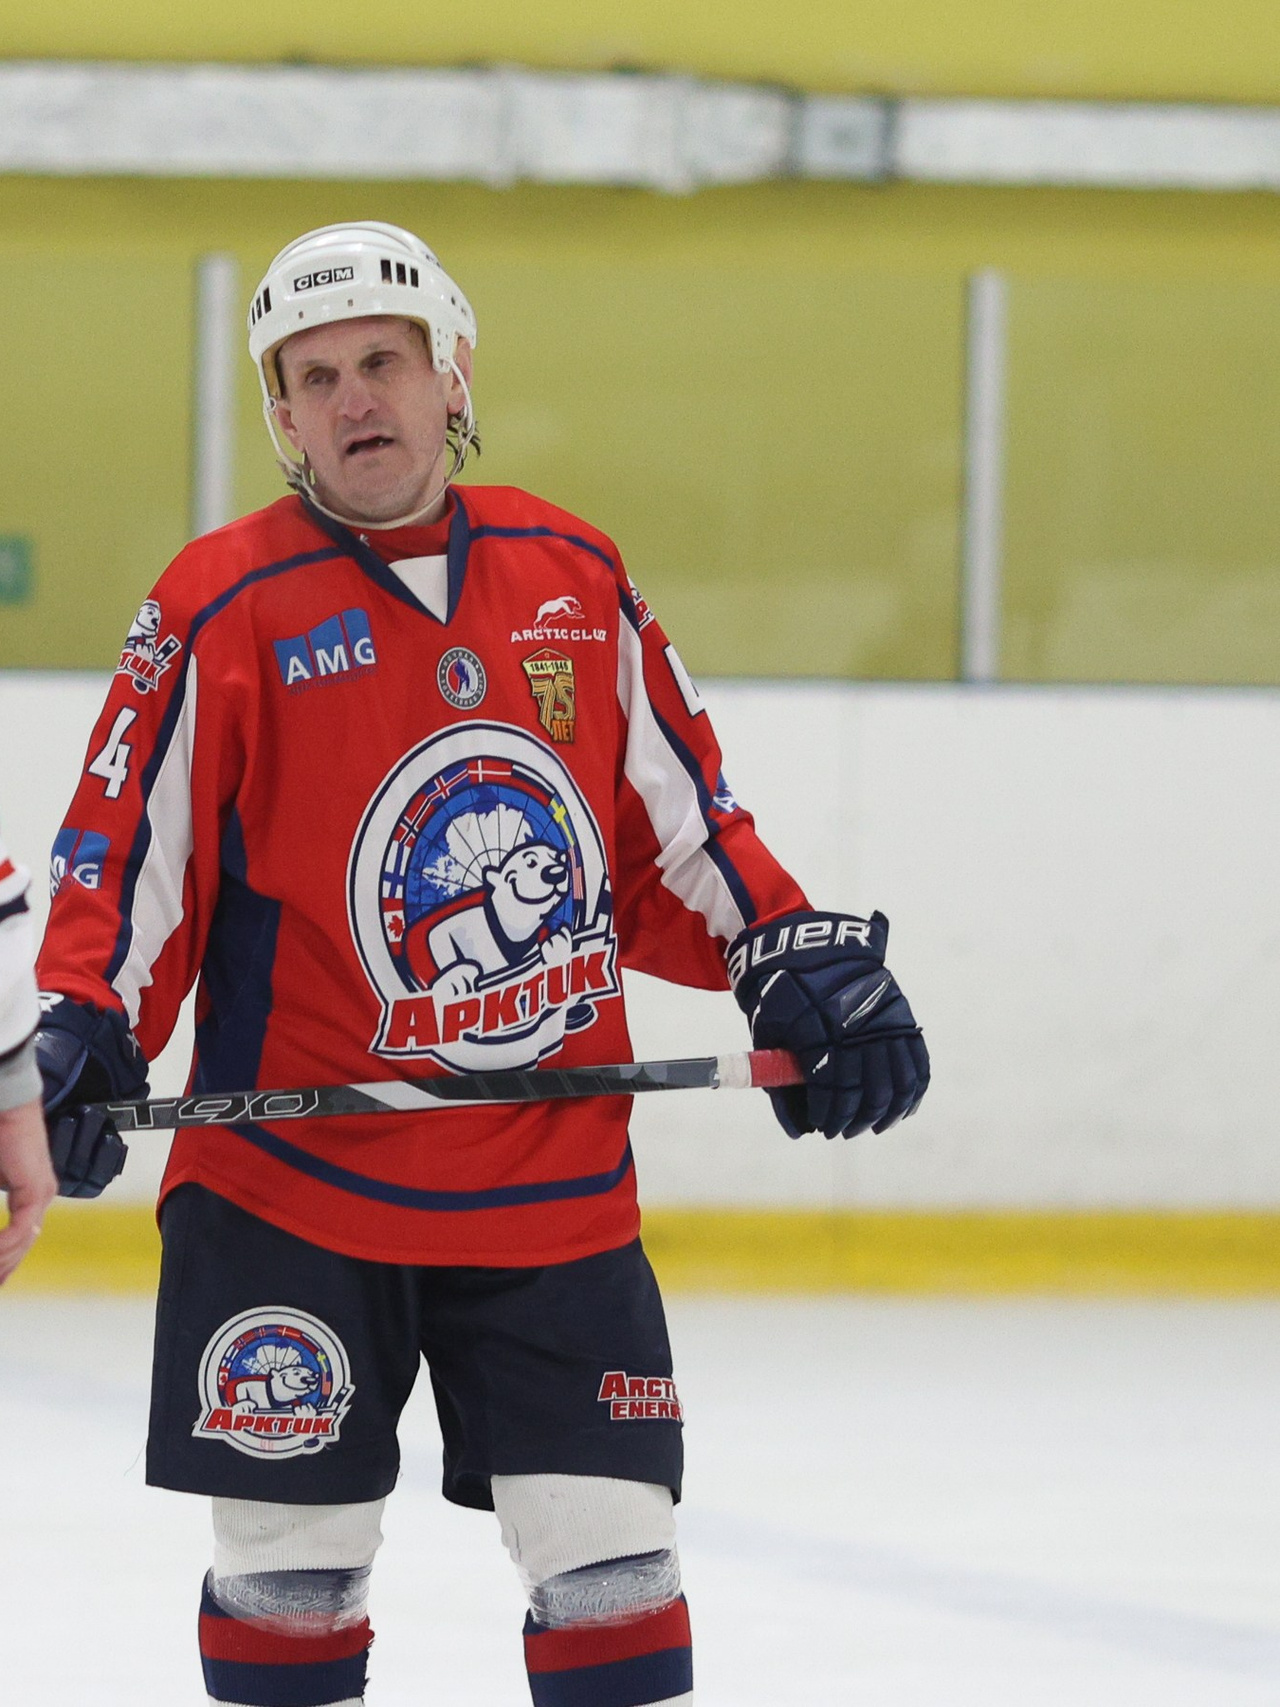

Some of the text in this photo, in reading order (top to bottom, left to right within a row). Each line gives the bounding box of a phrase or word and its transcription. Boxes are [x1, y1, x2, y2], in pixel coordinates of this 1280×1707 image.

[294, 266, 353, 291] CCM
[511, 629, 568, 642] ARCTIC
[286, 637, 376, 686] AMG
[87, 706, 138, 800] 4
[107, 1090, 319, 1129] T90
